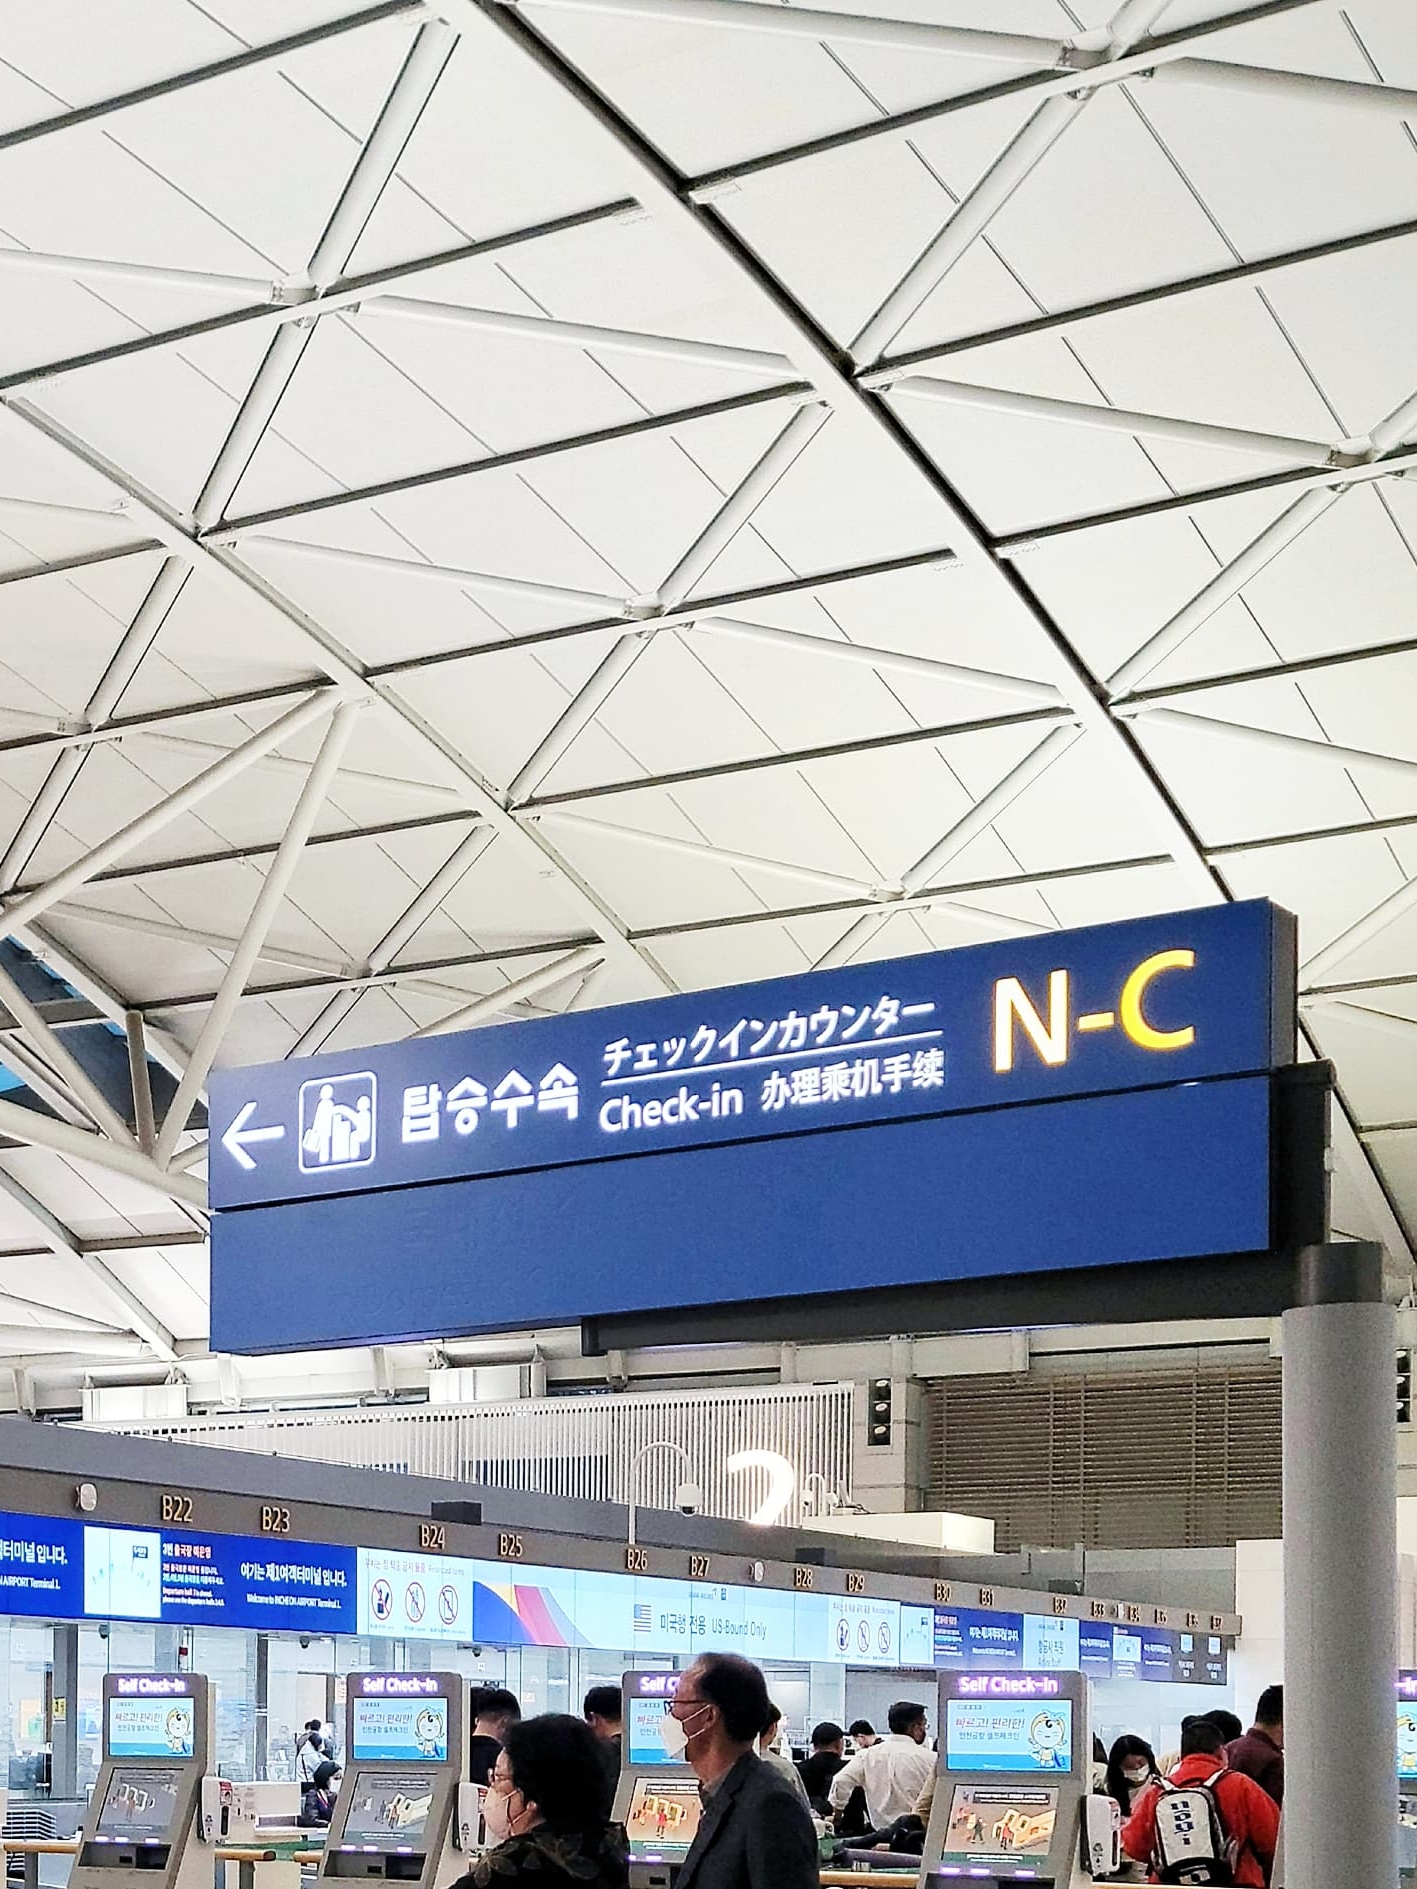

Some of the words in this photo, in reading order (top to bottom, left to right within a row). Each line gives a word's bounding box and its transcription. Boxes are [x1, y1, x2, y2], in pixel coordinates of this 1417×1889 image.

[993, 948, 1196, 1074] N-C
[603, 995, 935, 1076] チェックインカウンター
[761, 1049, 945, 1111] 办理乘机手续
[401, 1062, 580, 1143] 탑승수속
[599, 1085, 743, 1133] Check-in
[162, 1494, 194, 1523] B22
[261, 1506, 291, 1534] B23
[419, 1524, 446, 1550] B24
[498, 1532, 524, 1558] B25
[36, 1544, 68, 1565] 입니다.
[626, 1549, 648, 1571] B26
[689, 1555, 711, 1577] B27
[794, 1567, 813, 1589] B28
[846, 1573, 865, 1594] B29
[660, 1613, 686, 1635] 미국행
[689, 1615, 706, 1636] 전용
[712, 1619, 748, 1638] US-Bound
[750, 1621, 767, 1641] Only
[117, 1678, 138, 1693] Self
[362, 1677, 386, 1693] Self
[640, 1676, 667, 1692] Self
[958, 1676, 990, 1693] Self
